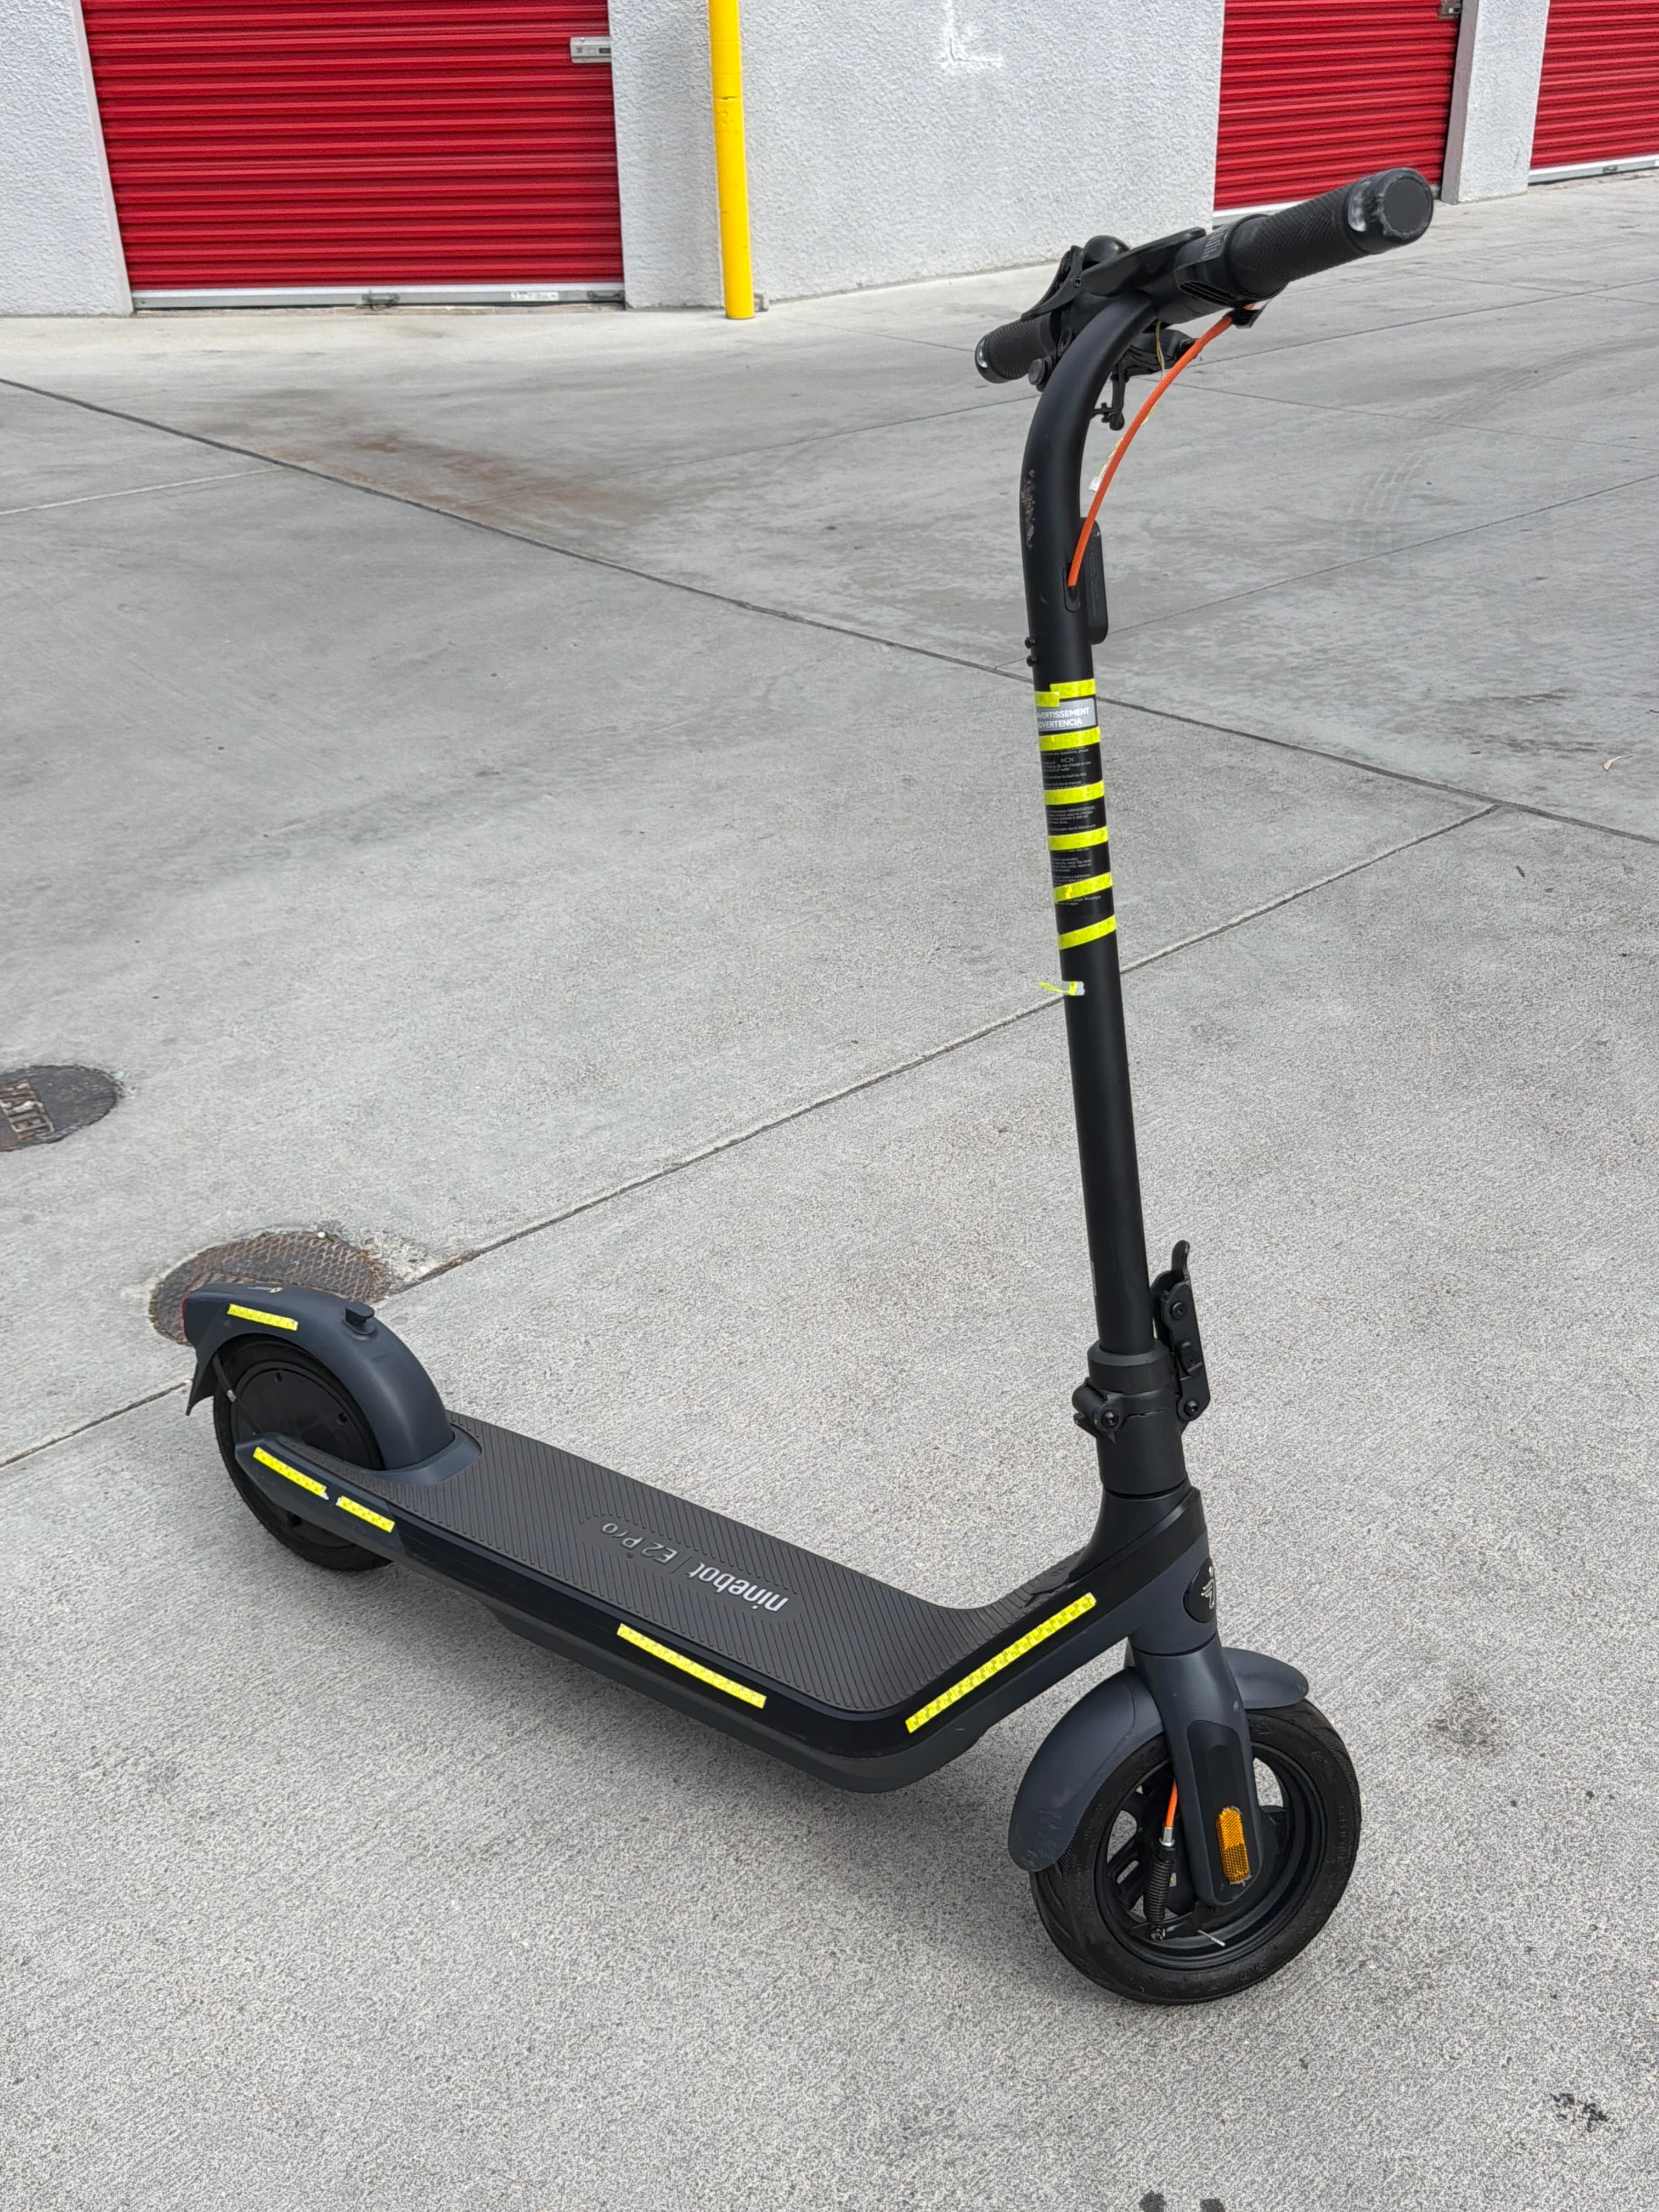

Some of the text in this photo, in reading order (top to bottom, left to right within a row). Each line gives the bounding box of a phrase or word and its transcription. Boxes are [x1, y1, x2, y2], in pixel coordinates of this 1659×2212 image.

[602, 1523, 789, 1612] ninebot E2 Pro
